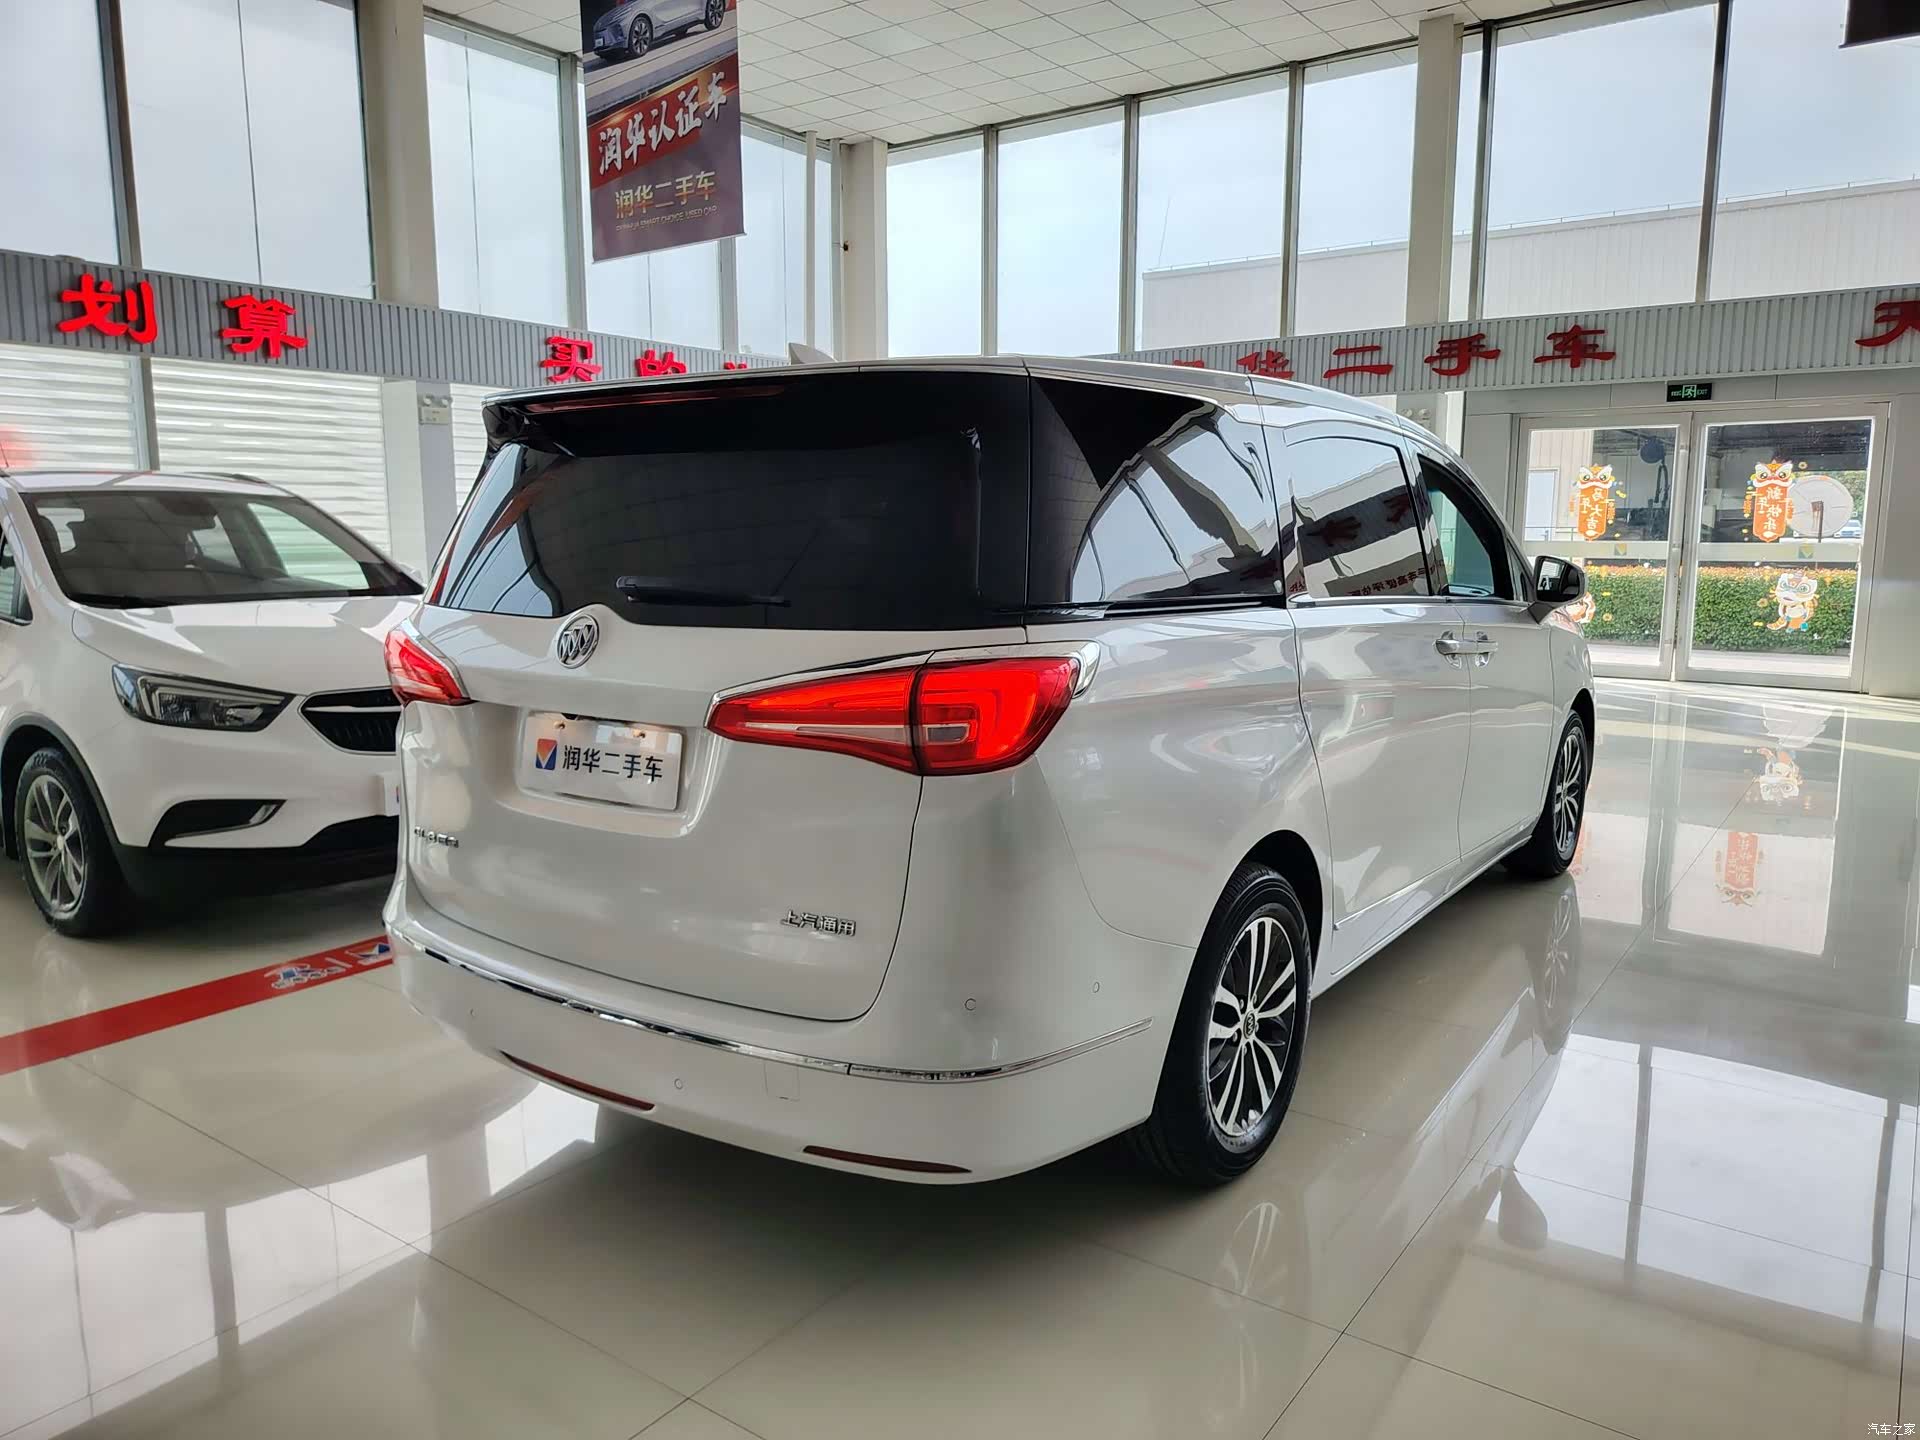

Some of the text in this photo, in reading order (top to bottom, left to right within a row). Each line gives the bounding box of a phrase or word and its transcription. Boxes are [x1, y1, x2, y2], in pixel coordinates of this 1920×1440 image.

[599, 72, 727, 175] 润华认证车
[616, 170, 716, 219] 润华二手车
[562, 745, 663, 782] 润华二手车
[781, 910, 857, 937] 上汽通用
